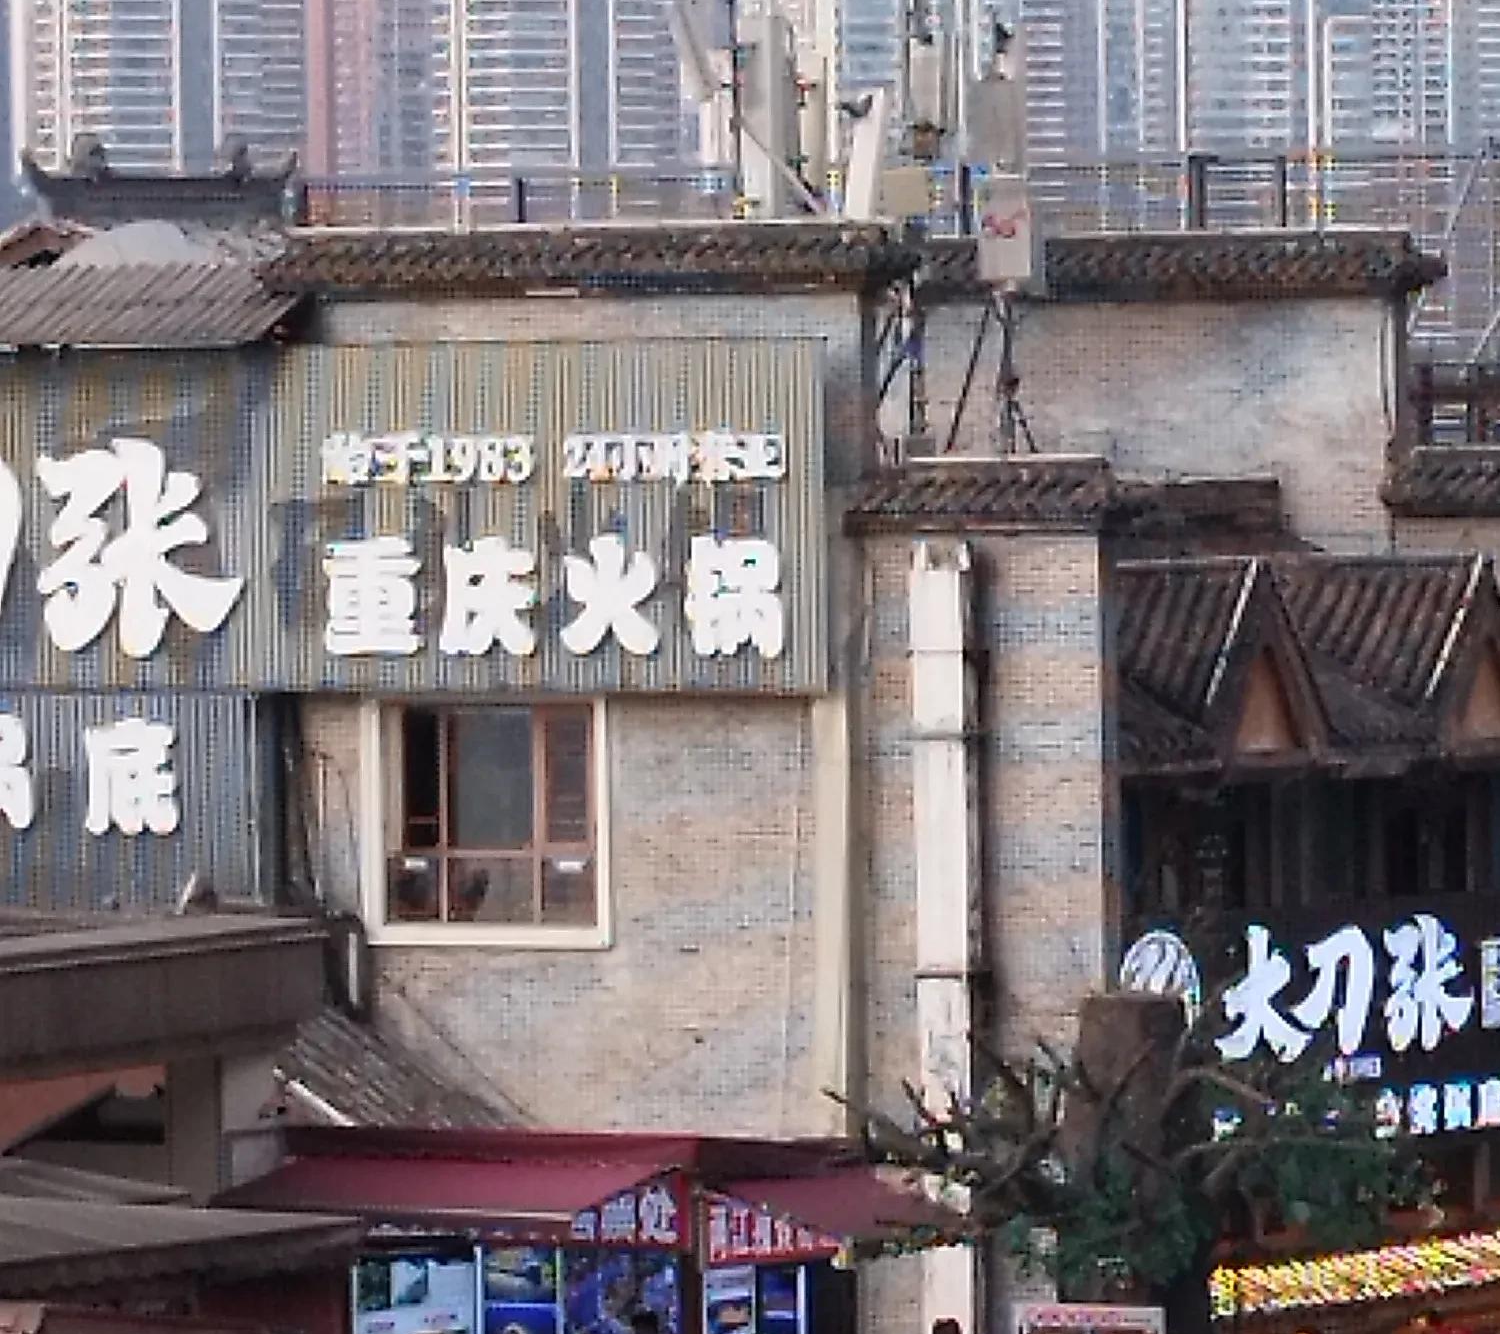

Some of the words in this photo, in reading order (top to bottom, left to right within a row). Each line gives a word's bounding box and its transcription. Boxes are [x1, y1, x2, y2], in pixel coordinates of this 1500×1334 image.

[0, 438, 241, 658] 张
[324, 536, 784, 658] 重庆火锅
[1214, 913, 1473, 1063] 大刀张
